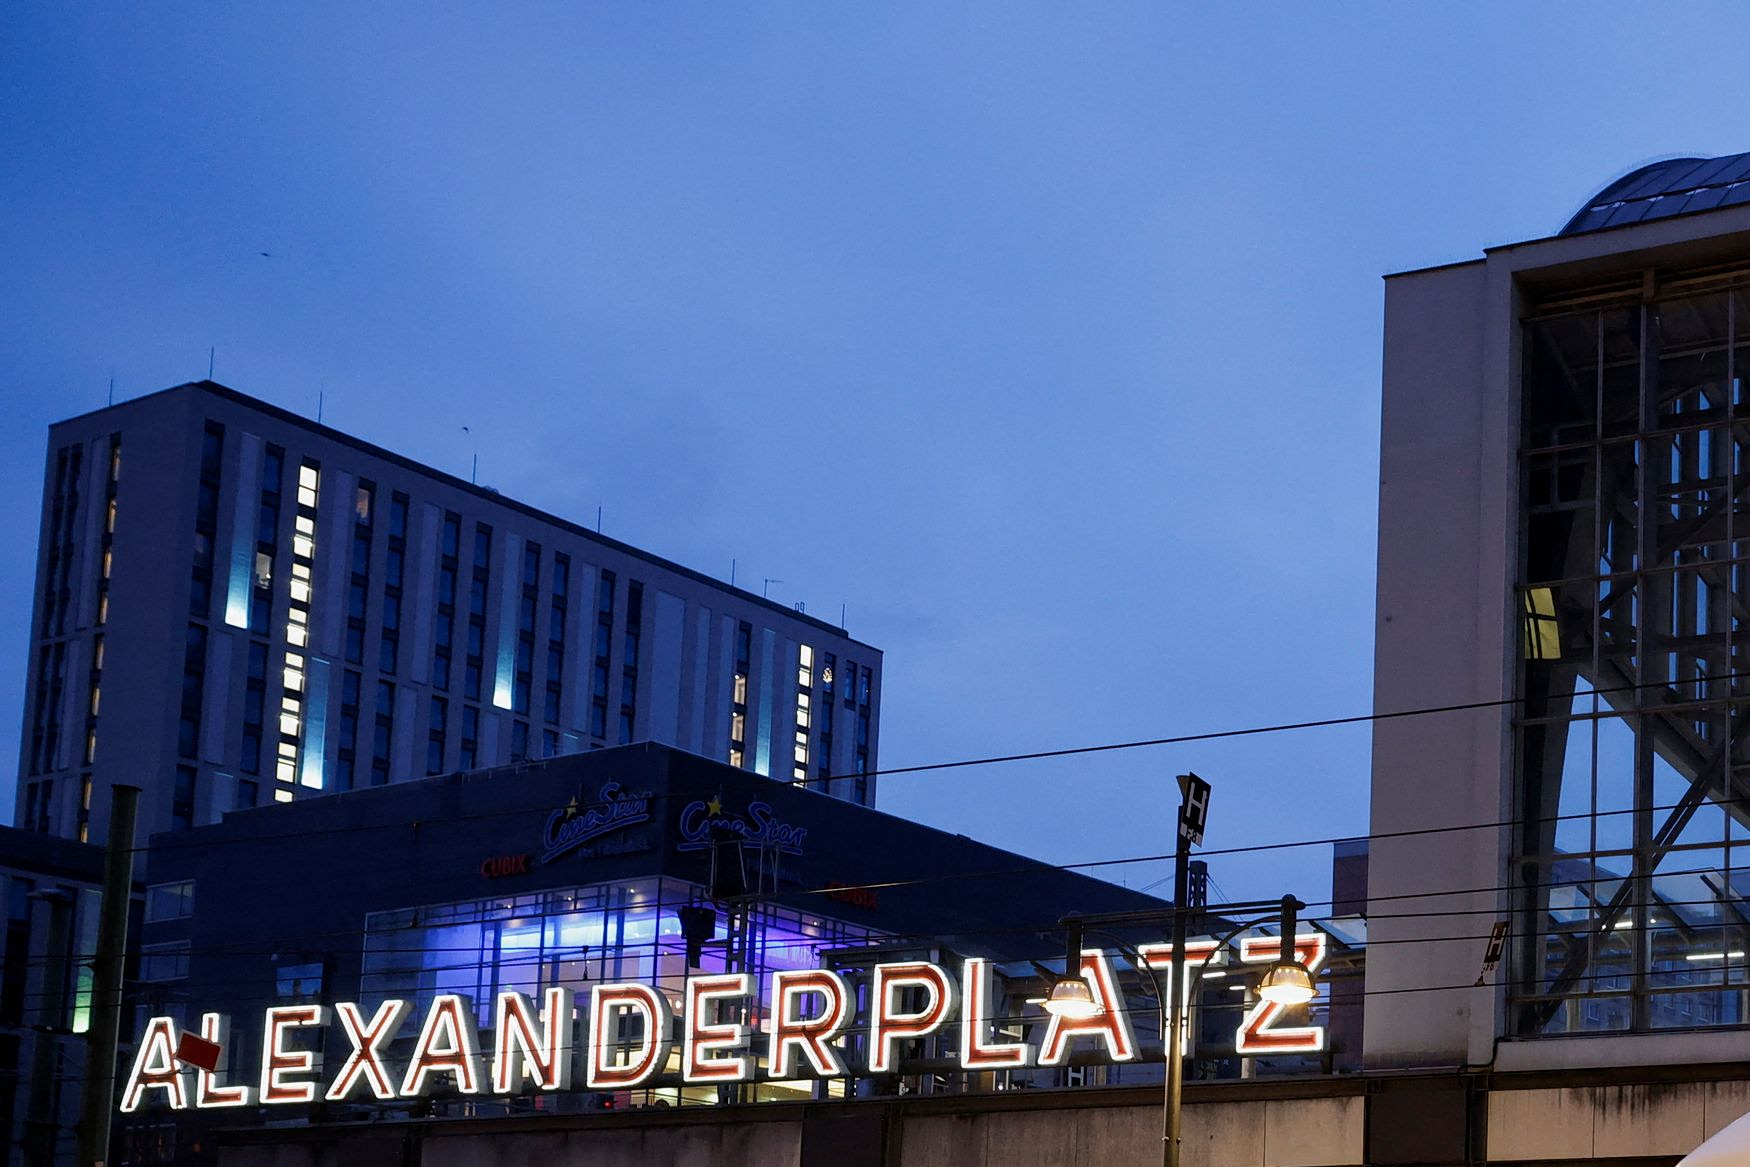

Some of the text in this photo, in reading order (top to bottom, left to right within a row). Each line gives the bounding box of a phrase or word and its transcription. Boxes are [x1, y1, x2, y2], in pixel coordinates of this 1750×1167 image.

[1185, 781, 1208, 826] H
[480, 855, 529, 879] CUBIX
[1487, 926, 1507, 957] H
[119, 931, 1327, 1112] ALEXANDERPLATZ
